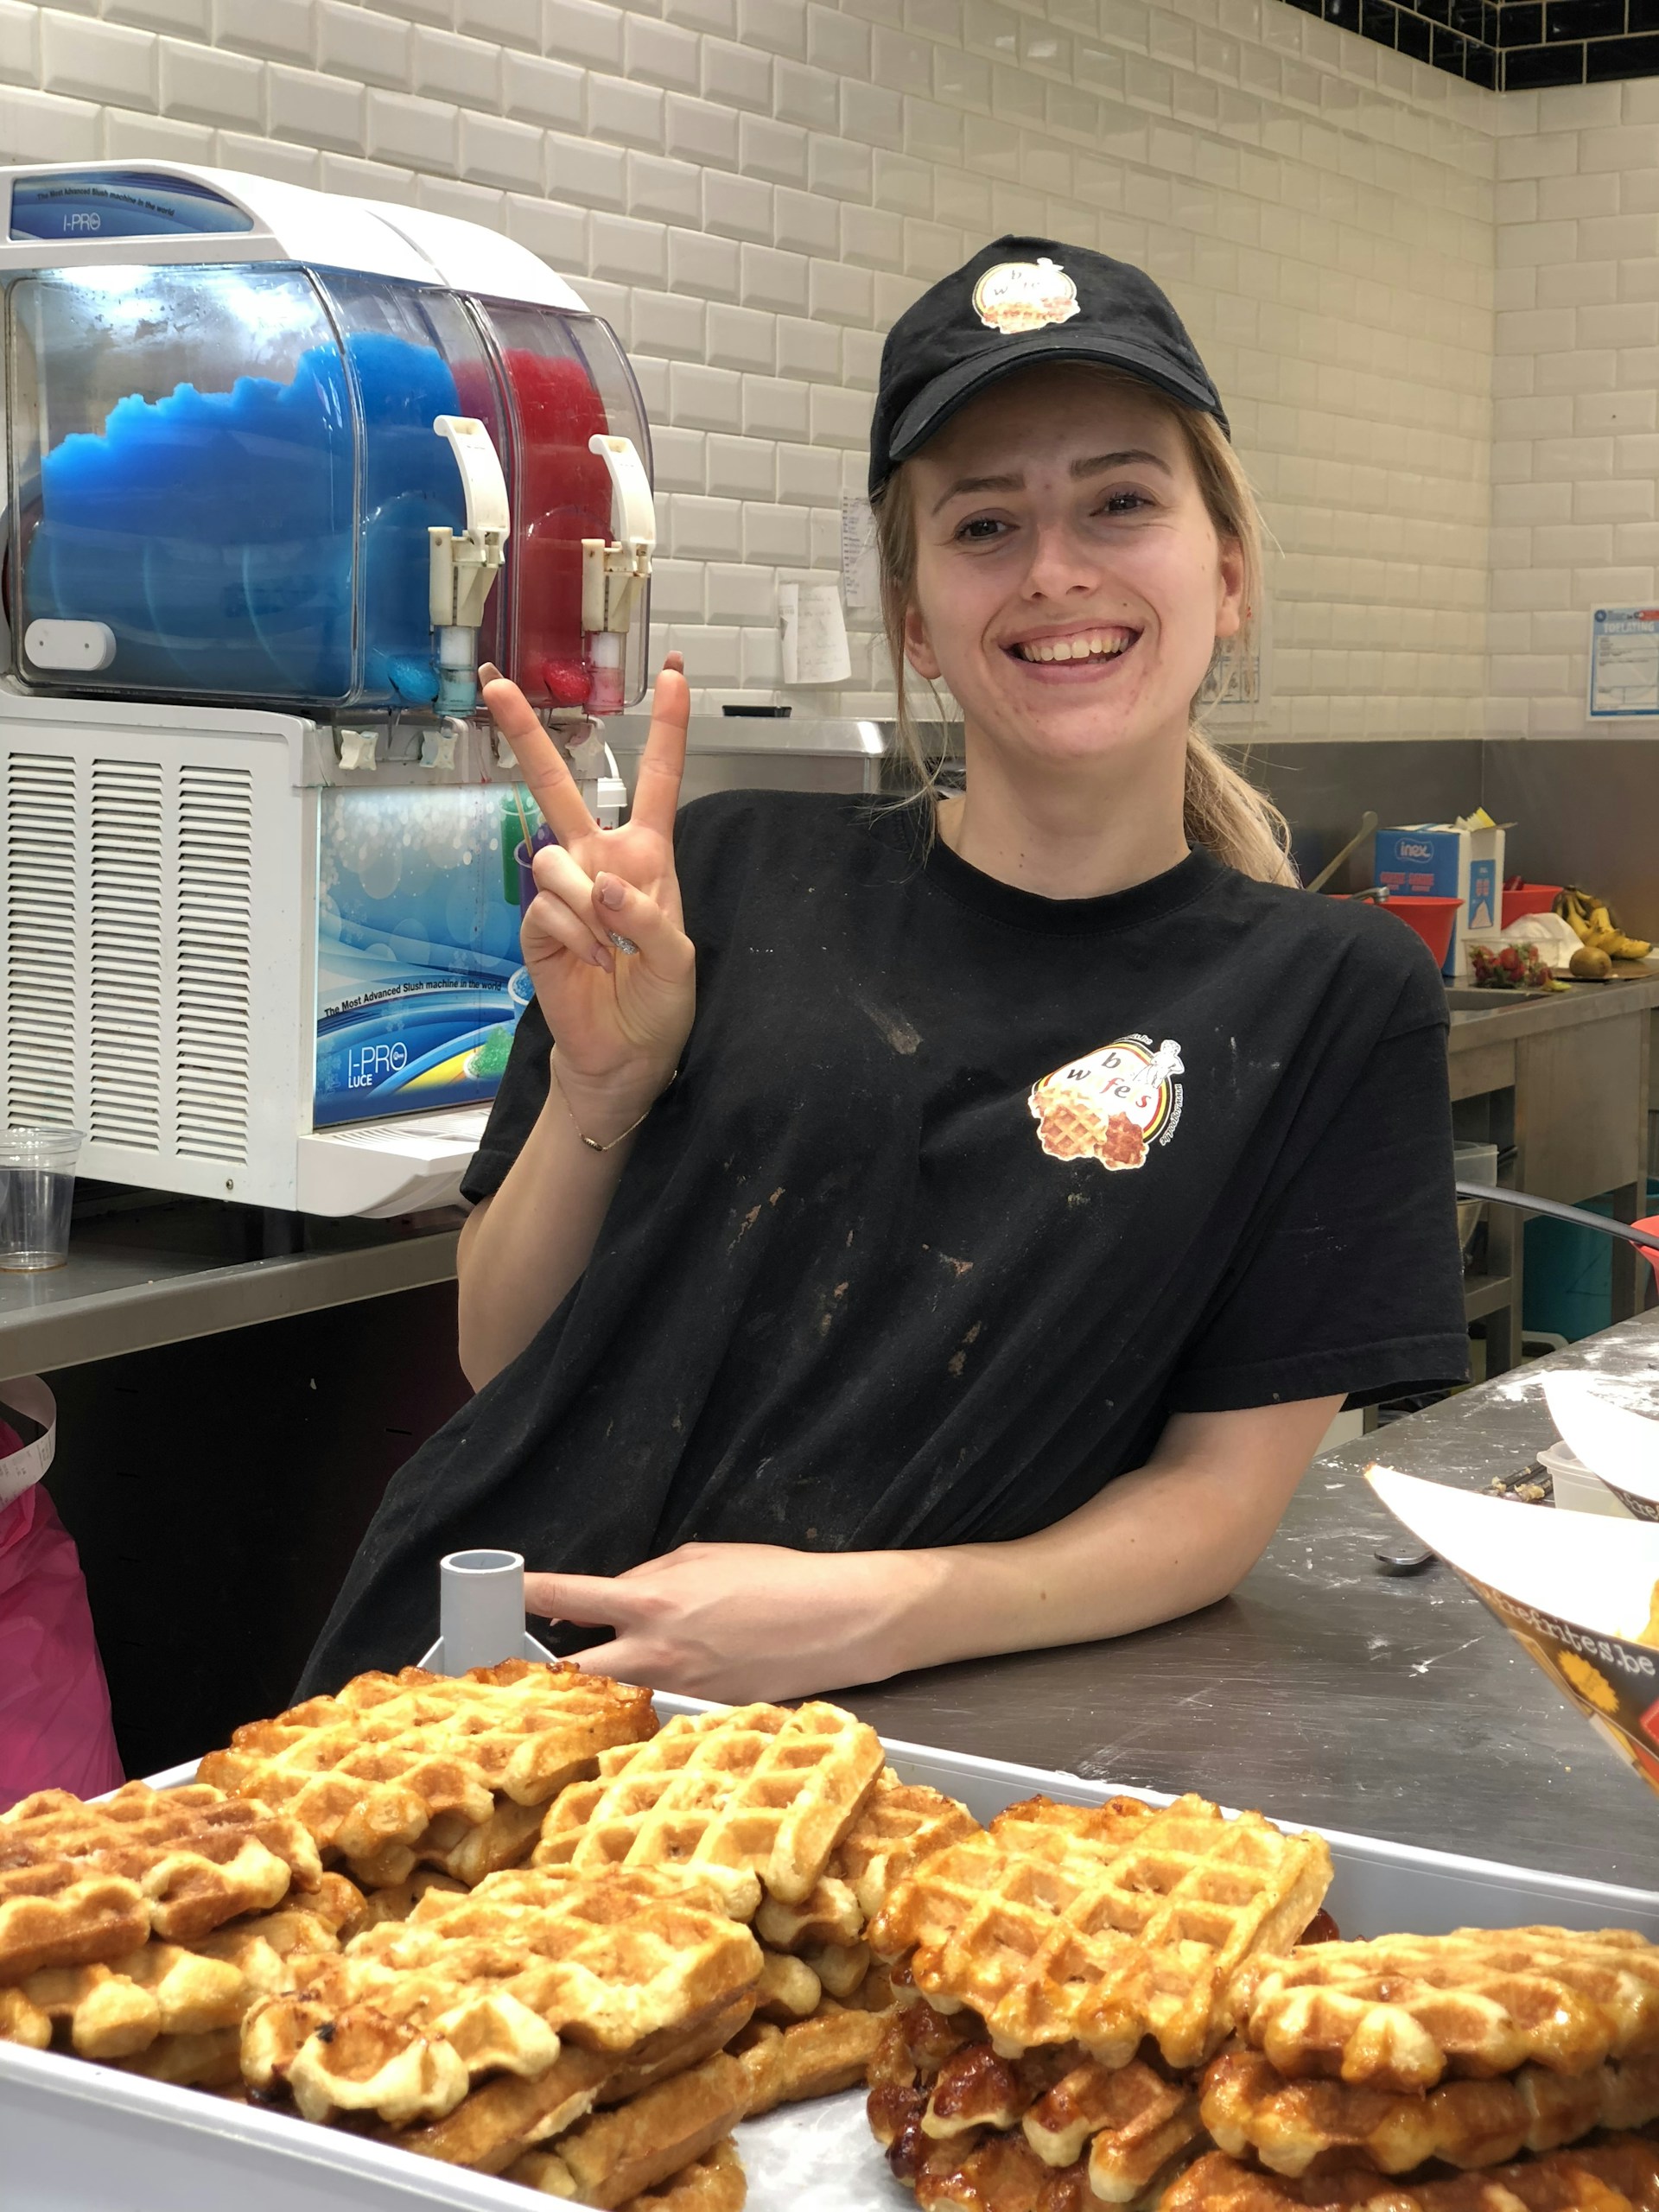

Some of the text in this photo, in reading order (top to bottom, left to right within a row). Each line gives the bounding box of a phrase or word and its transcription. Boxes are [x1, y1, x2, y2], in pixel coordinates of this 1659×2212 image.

[50, 189, 63, 198] Most
[92, 188, 108, 197] Slush
[110, 192, 136, 204] machine
[137, 198, 144, 207] in
[145, 200, 156, 210] the
[157, 205, 175, 216] world
[63, 212, 101, 232] I-PRO
[1400, 841, 1431, 858] inex
[324, 979, 502, 1018] The Most Advanced Slush machine in the world
[348, 1042, 408, 1077] I-PRO
[348, 1073, 373, 1089] LUCE
